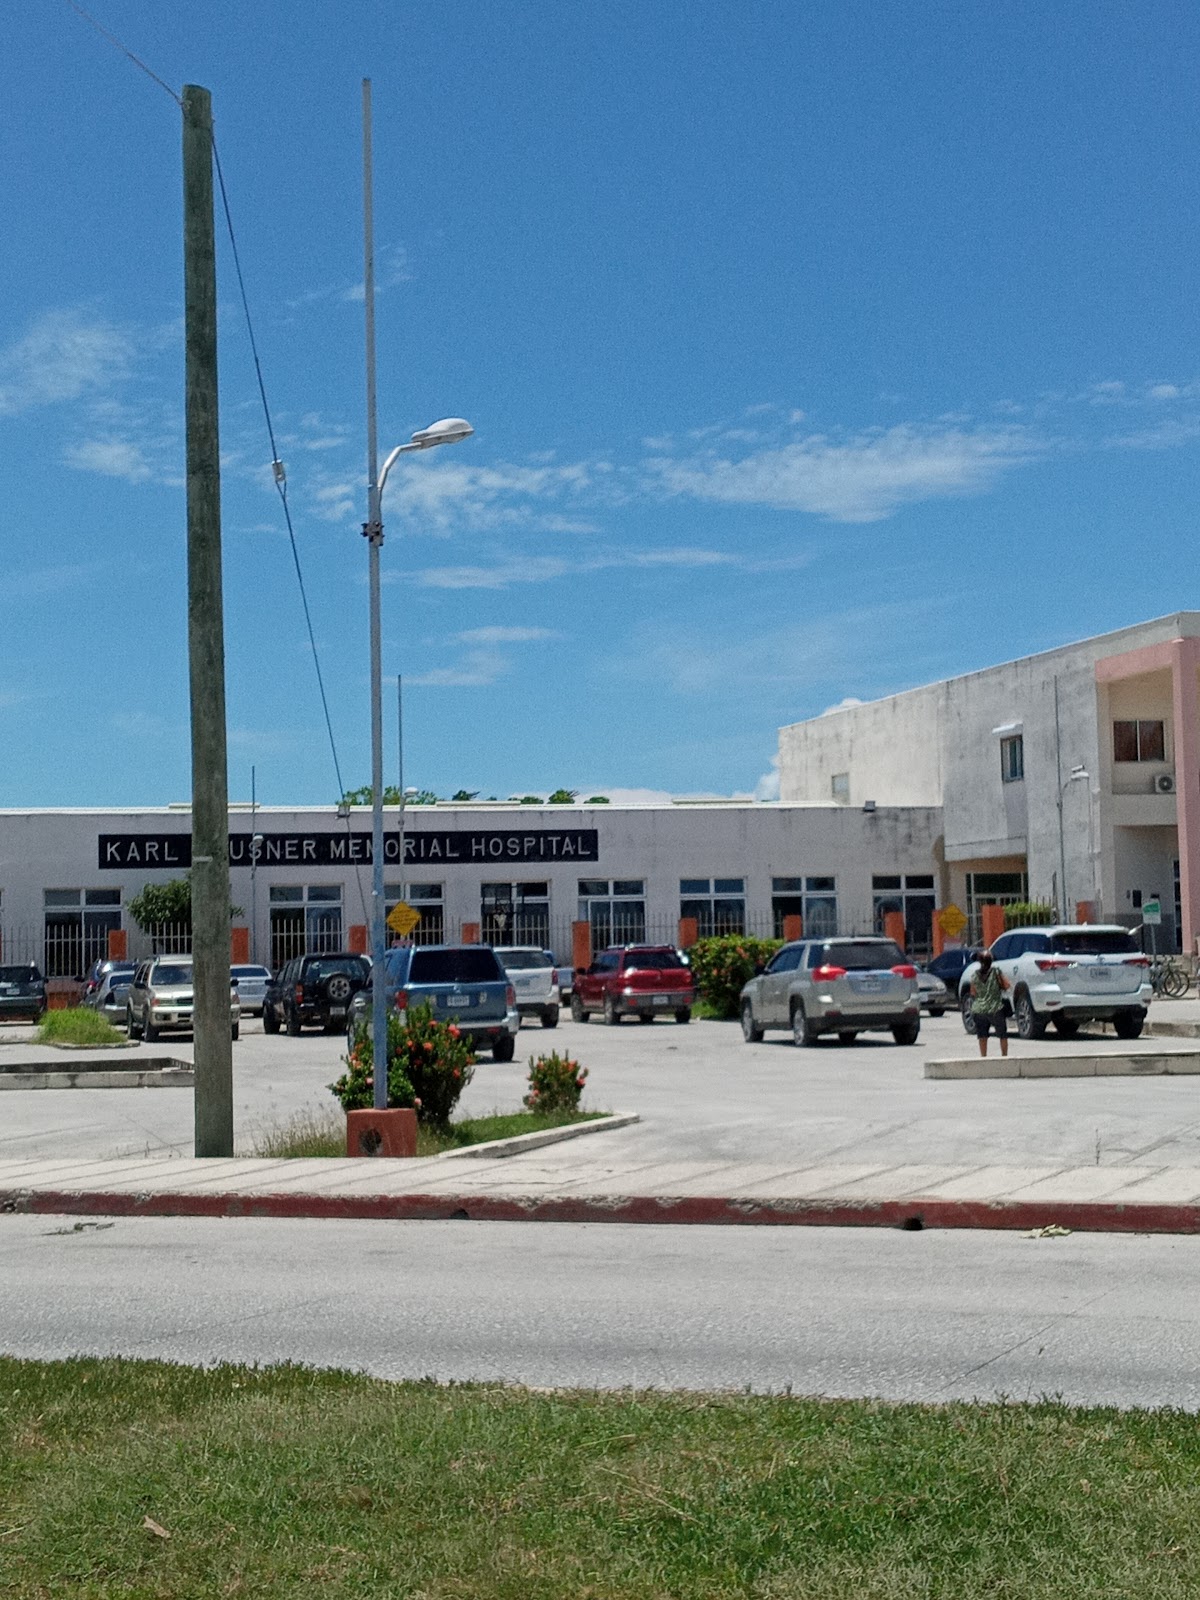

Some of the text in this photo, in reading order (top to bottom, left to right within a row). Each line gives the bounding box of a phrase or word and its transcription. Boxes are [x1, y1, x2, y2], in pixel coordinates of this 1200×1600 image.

[106, 841, 179, 862] KARL
[229, 839, 317, 860] USNER
[471, 836, 591, 857] HOSPITAL
